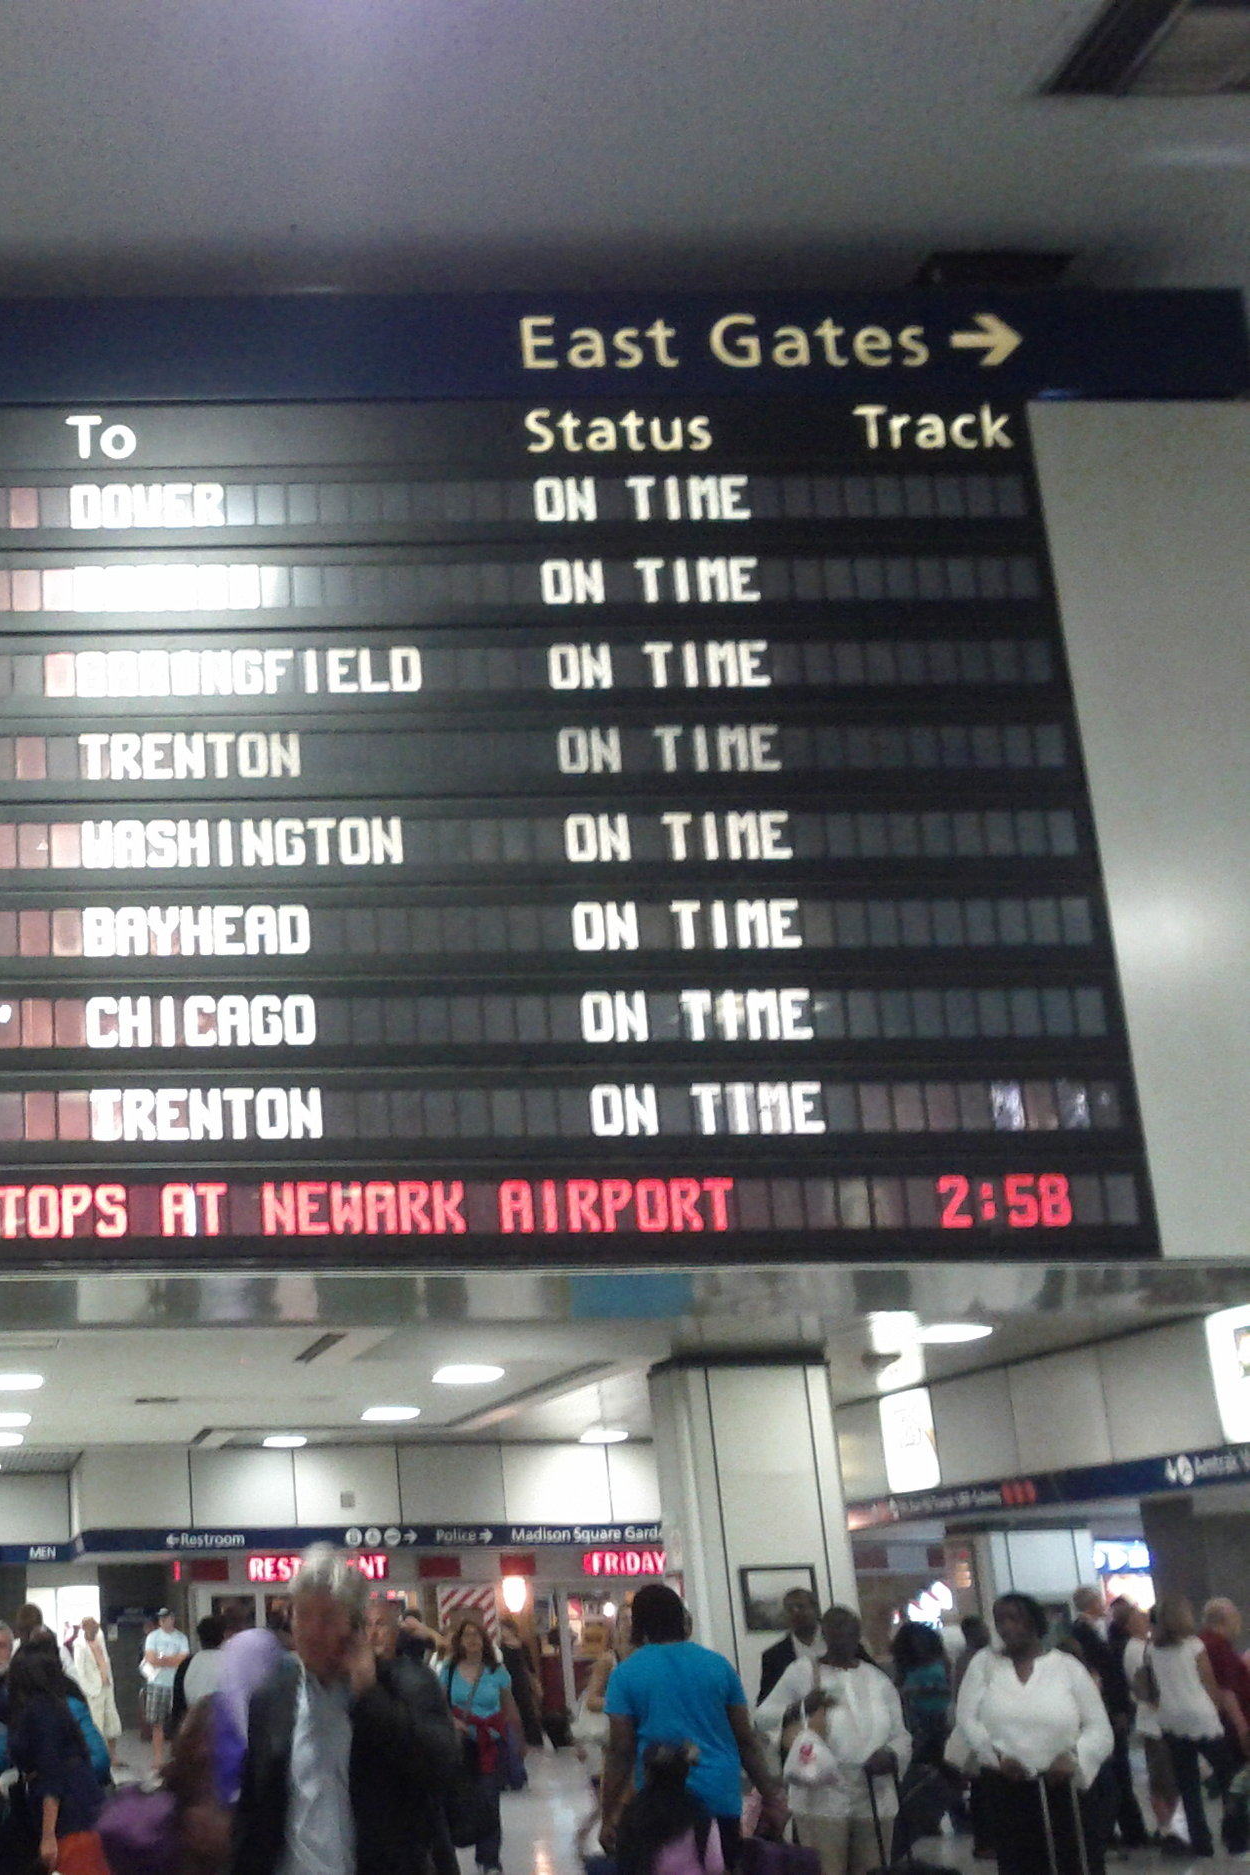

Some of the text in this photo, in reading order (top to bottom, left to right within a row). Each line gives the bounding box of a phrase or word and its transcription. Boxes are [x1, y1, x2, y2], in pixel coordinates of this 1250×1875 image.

[519, 313, 931, 370] East Gates
[65, 414, 137, 459] To
[523, 407, 712, 453] Status
[852, 404, 1014, 450] Track
[69, 482, 225, 529] DOVER
[533, 474, 752, 522] ON TIME
[540, 556, 761, 605] ON TIME
[74, 644, 423, 698] NGFIELD
[548, 640, 771, 690] ON TIME
[78, 732, 302, 780] TRENTON
[557, 724, 782, 774] ON TIME
[81, 815, 404, 869] WASHINGTON
[564, 810, 794, 863] ON TIME
[81, 903, 312, 957] BAYHEAD
[571, 899, 803, 952] ON TIME
[85, 994, 317, 1048] CHICAGO
[580, 988, 814, 1043] ON TIME
[90, 1088, 324, 1141] TRENTON
[590, 1081, 826, 1137] ON TIME
[160, 1182, 227, 1237] AT
[260, 1180, 467, 1236] NEWARK
[498, 1177, 734, 1233] AIRPORT
[936, 1173, 1072, 1229] 2:58
[29, 1546, 56, 1561] MEN
[180, 1533, 245, 1547] Restroom
[436, 1528, 477, 1542] Police
[510, 1528, 572, 1544] Madison
[572, 1527, 621, 1544] Square
